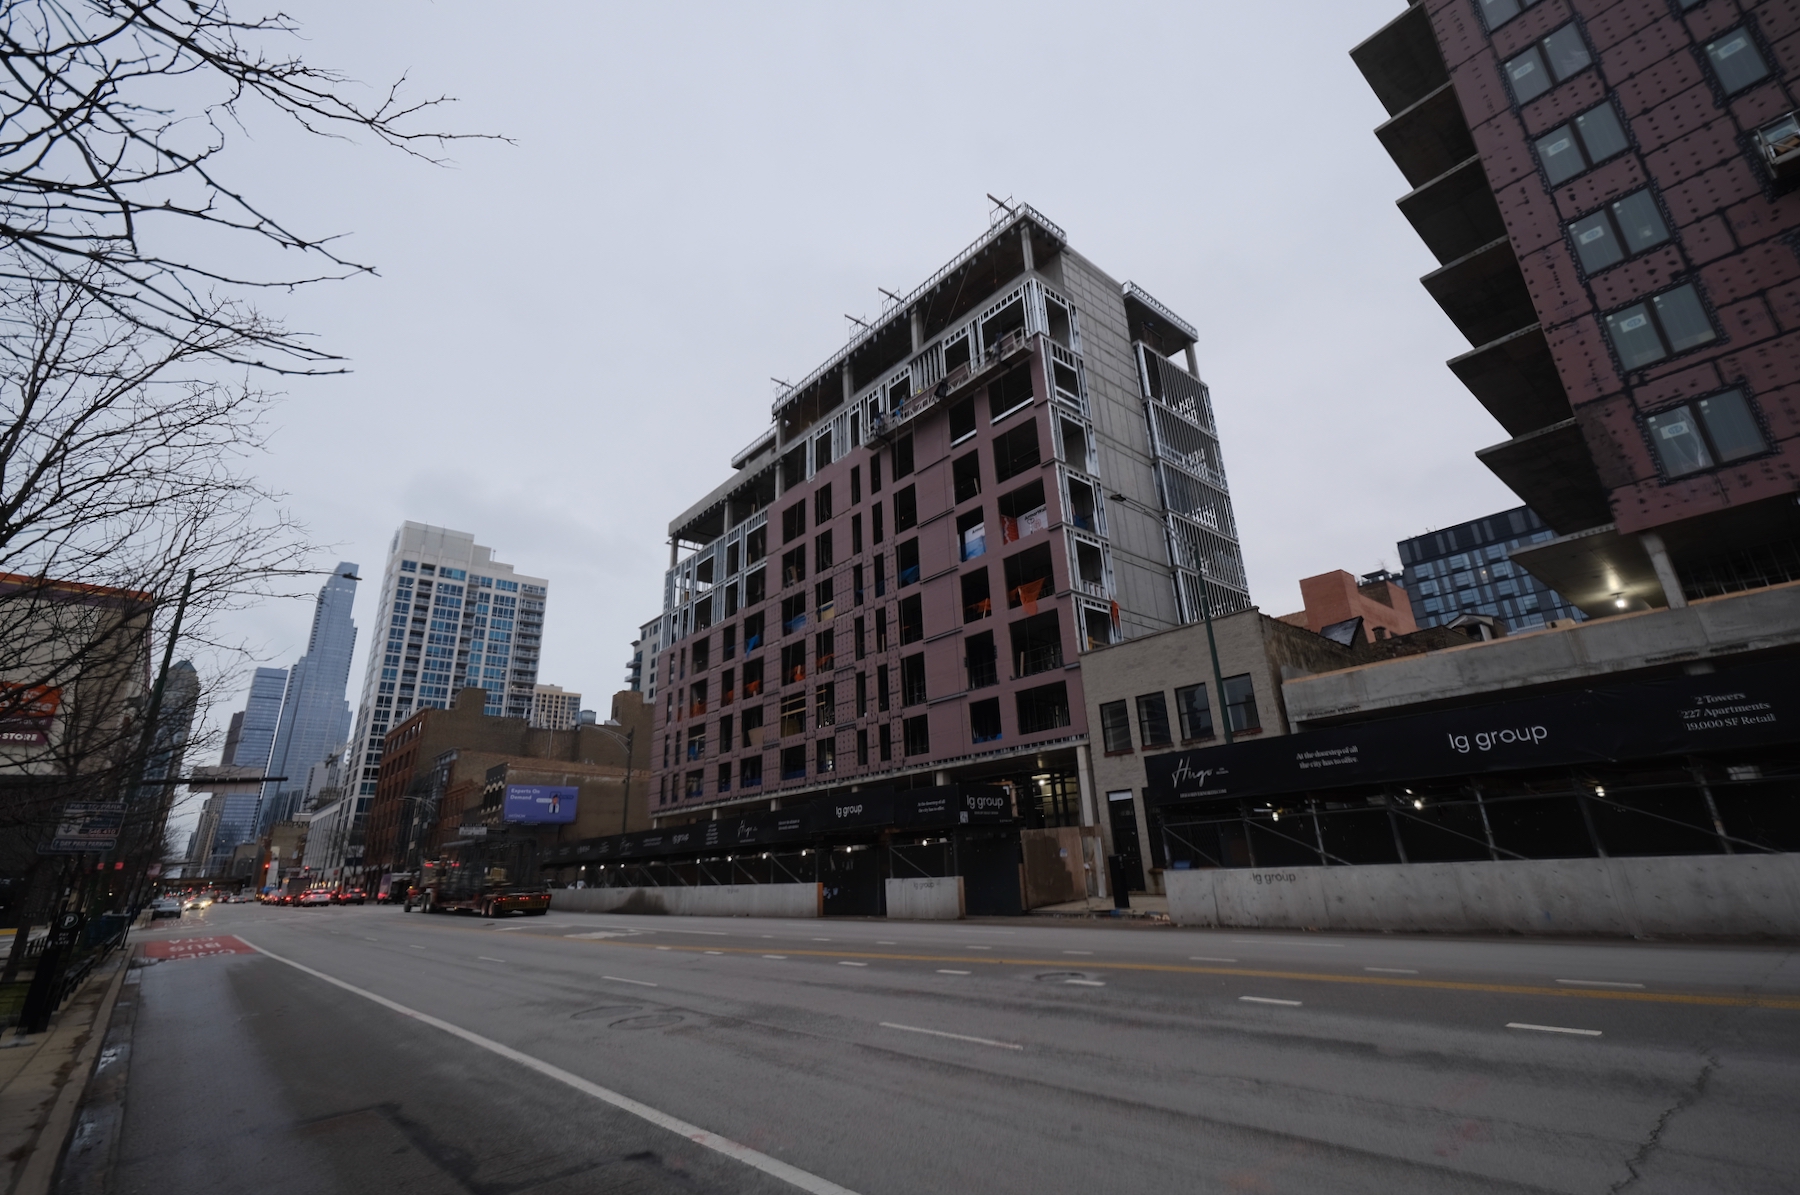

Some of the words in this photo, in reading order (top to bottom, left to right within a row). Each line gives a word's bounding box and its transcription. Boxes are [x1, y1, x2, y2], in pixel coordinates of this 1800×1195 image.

[1695, 696, 1704, 705] 2
[1704, 693, 1746, 704] Towers
[1681, 709, 1701, 719] 227
[1703, 702, 1772, 718] Apartments
[1725, 717, 1739, 727] SF
[1741, 713, 1777, 725] Retail
[1475, 725, 1548, 752] group
[1171, 756, 1214, 788] Hugo
[976, 796, 1004, 810] group
[842, 804, 863, 817] group
[1264, 873, 1297, 885] group
[64, 915, 75, 926] P
[169, 942, 221, 951] BUS
